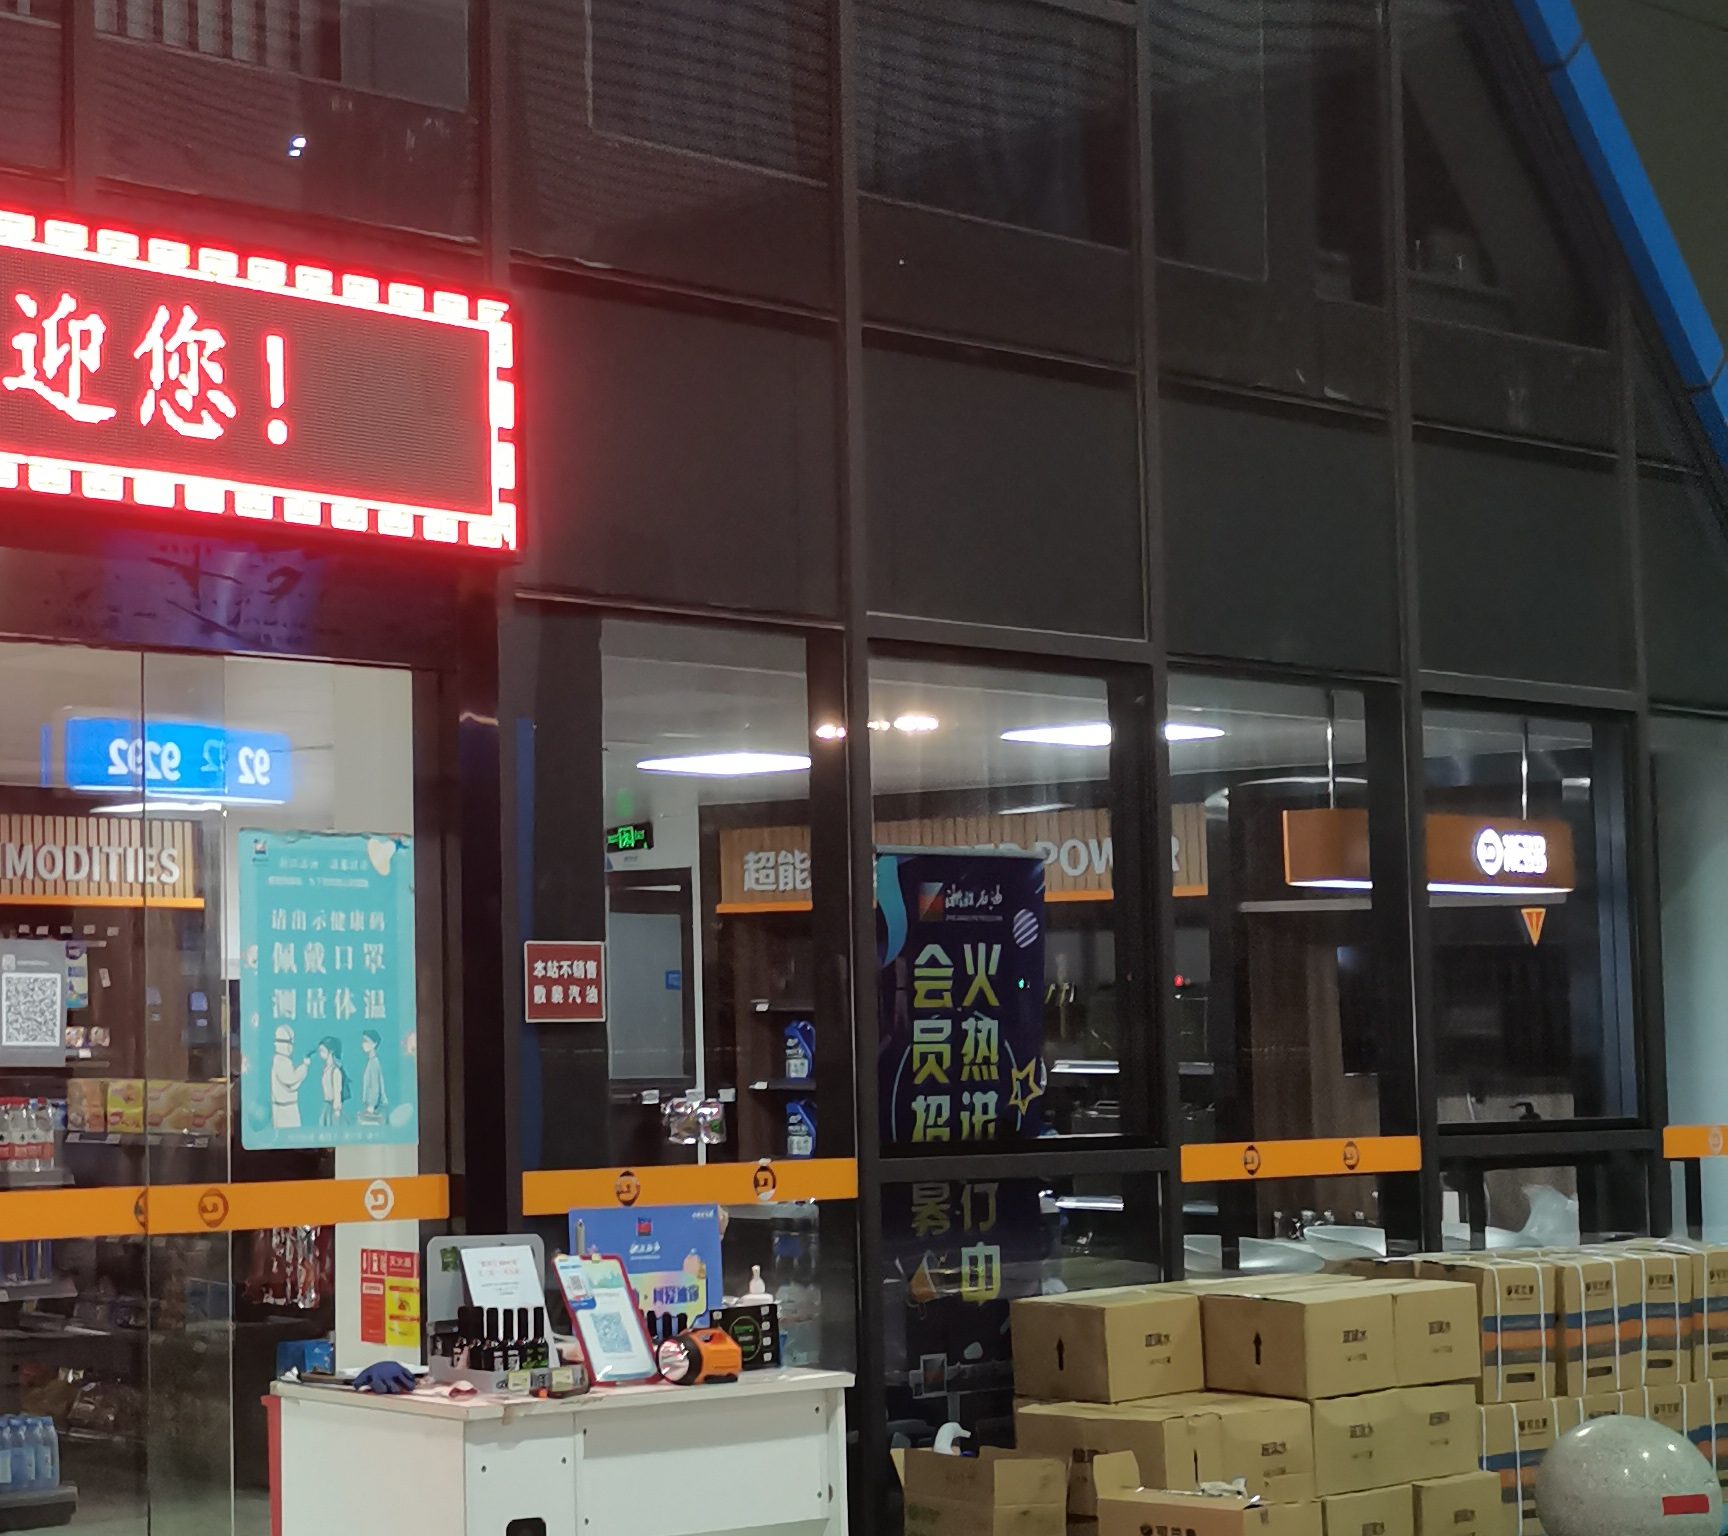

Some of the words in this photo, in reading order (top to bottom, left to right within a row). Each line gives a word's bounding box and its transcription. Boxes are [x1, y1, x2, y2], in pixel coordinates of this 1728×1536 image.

[743, 849, 812, 892] 超能
[272, 908, 385, 932] 请出示健康码
[273, 941, 386, 975] 佩戴口罩
[533, 959, 598, 979] 本站不销售
[271, 987, 387, 1021] 测量体温
